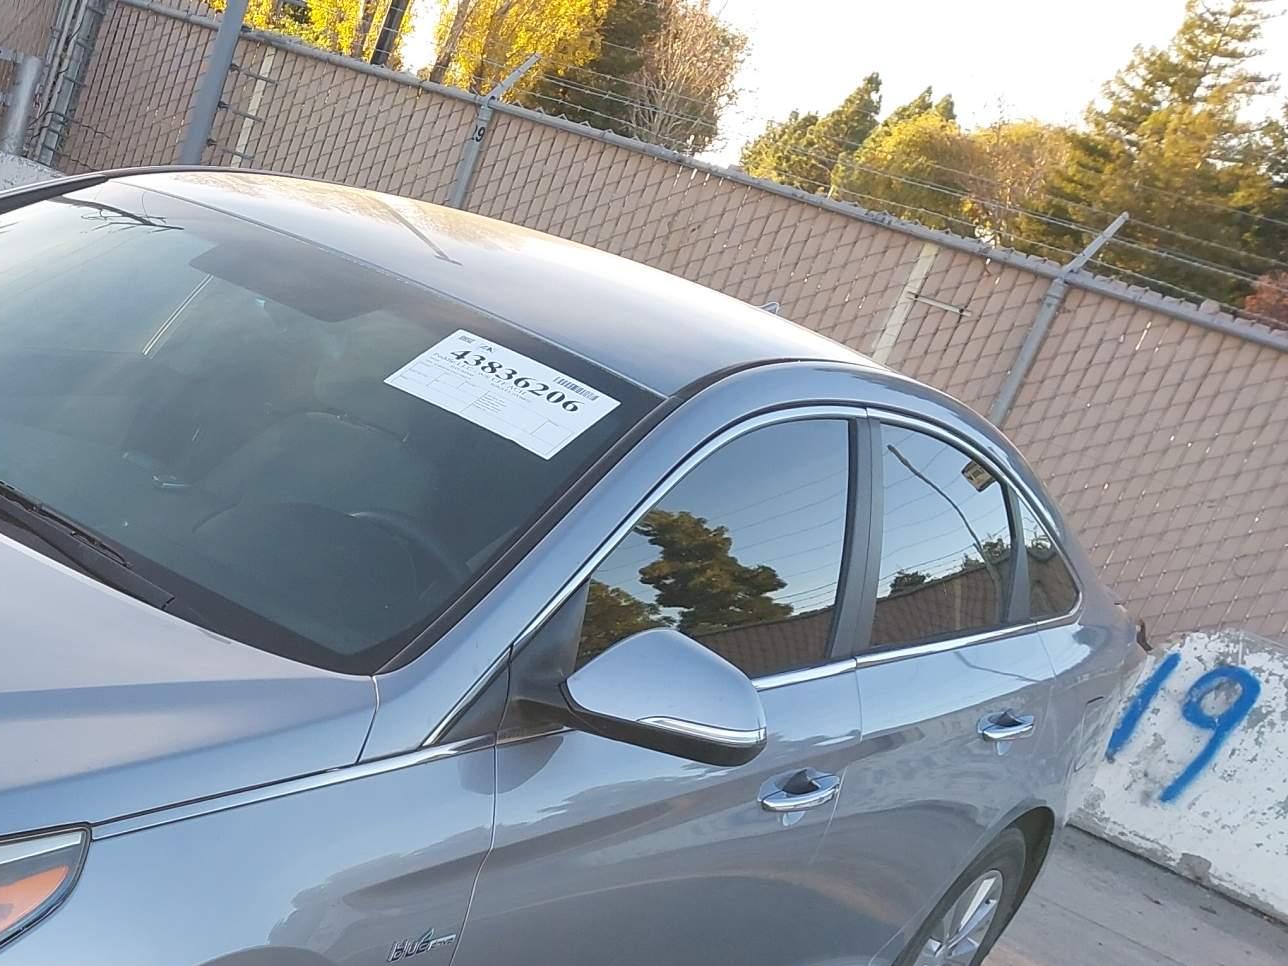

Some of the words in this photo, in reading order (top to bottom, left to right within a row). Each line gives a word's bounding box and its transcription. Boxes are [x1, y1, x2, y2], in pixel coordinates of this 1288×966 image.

[472, 125, 486, 143] 19
[450, 350, 585, 413] 43836206
[1105, 652, 1262, 803] 19
